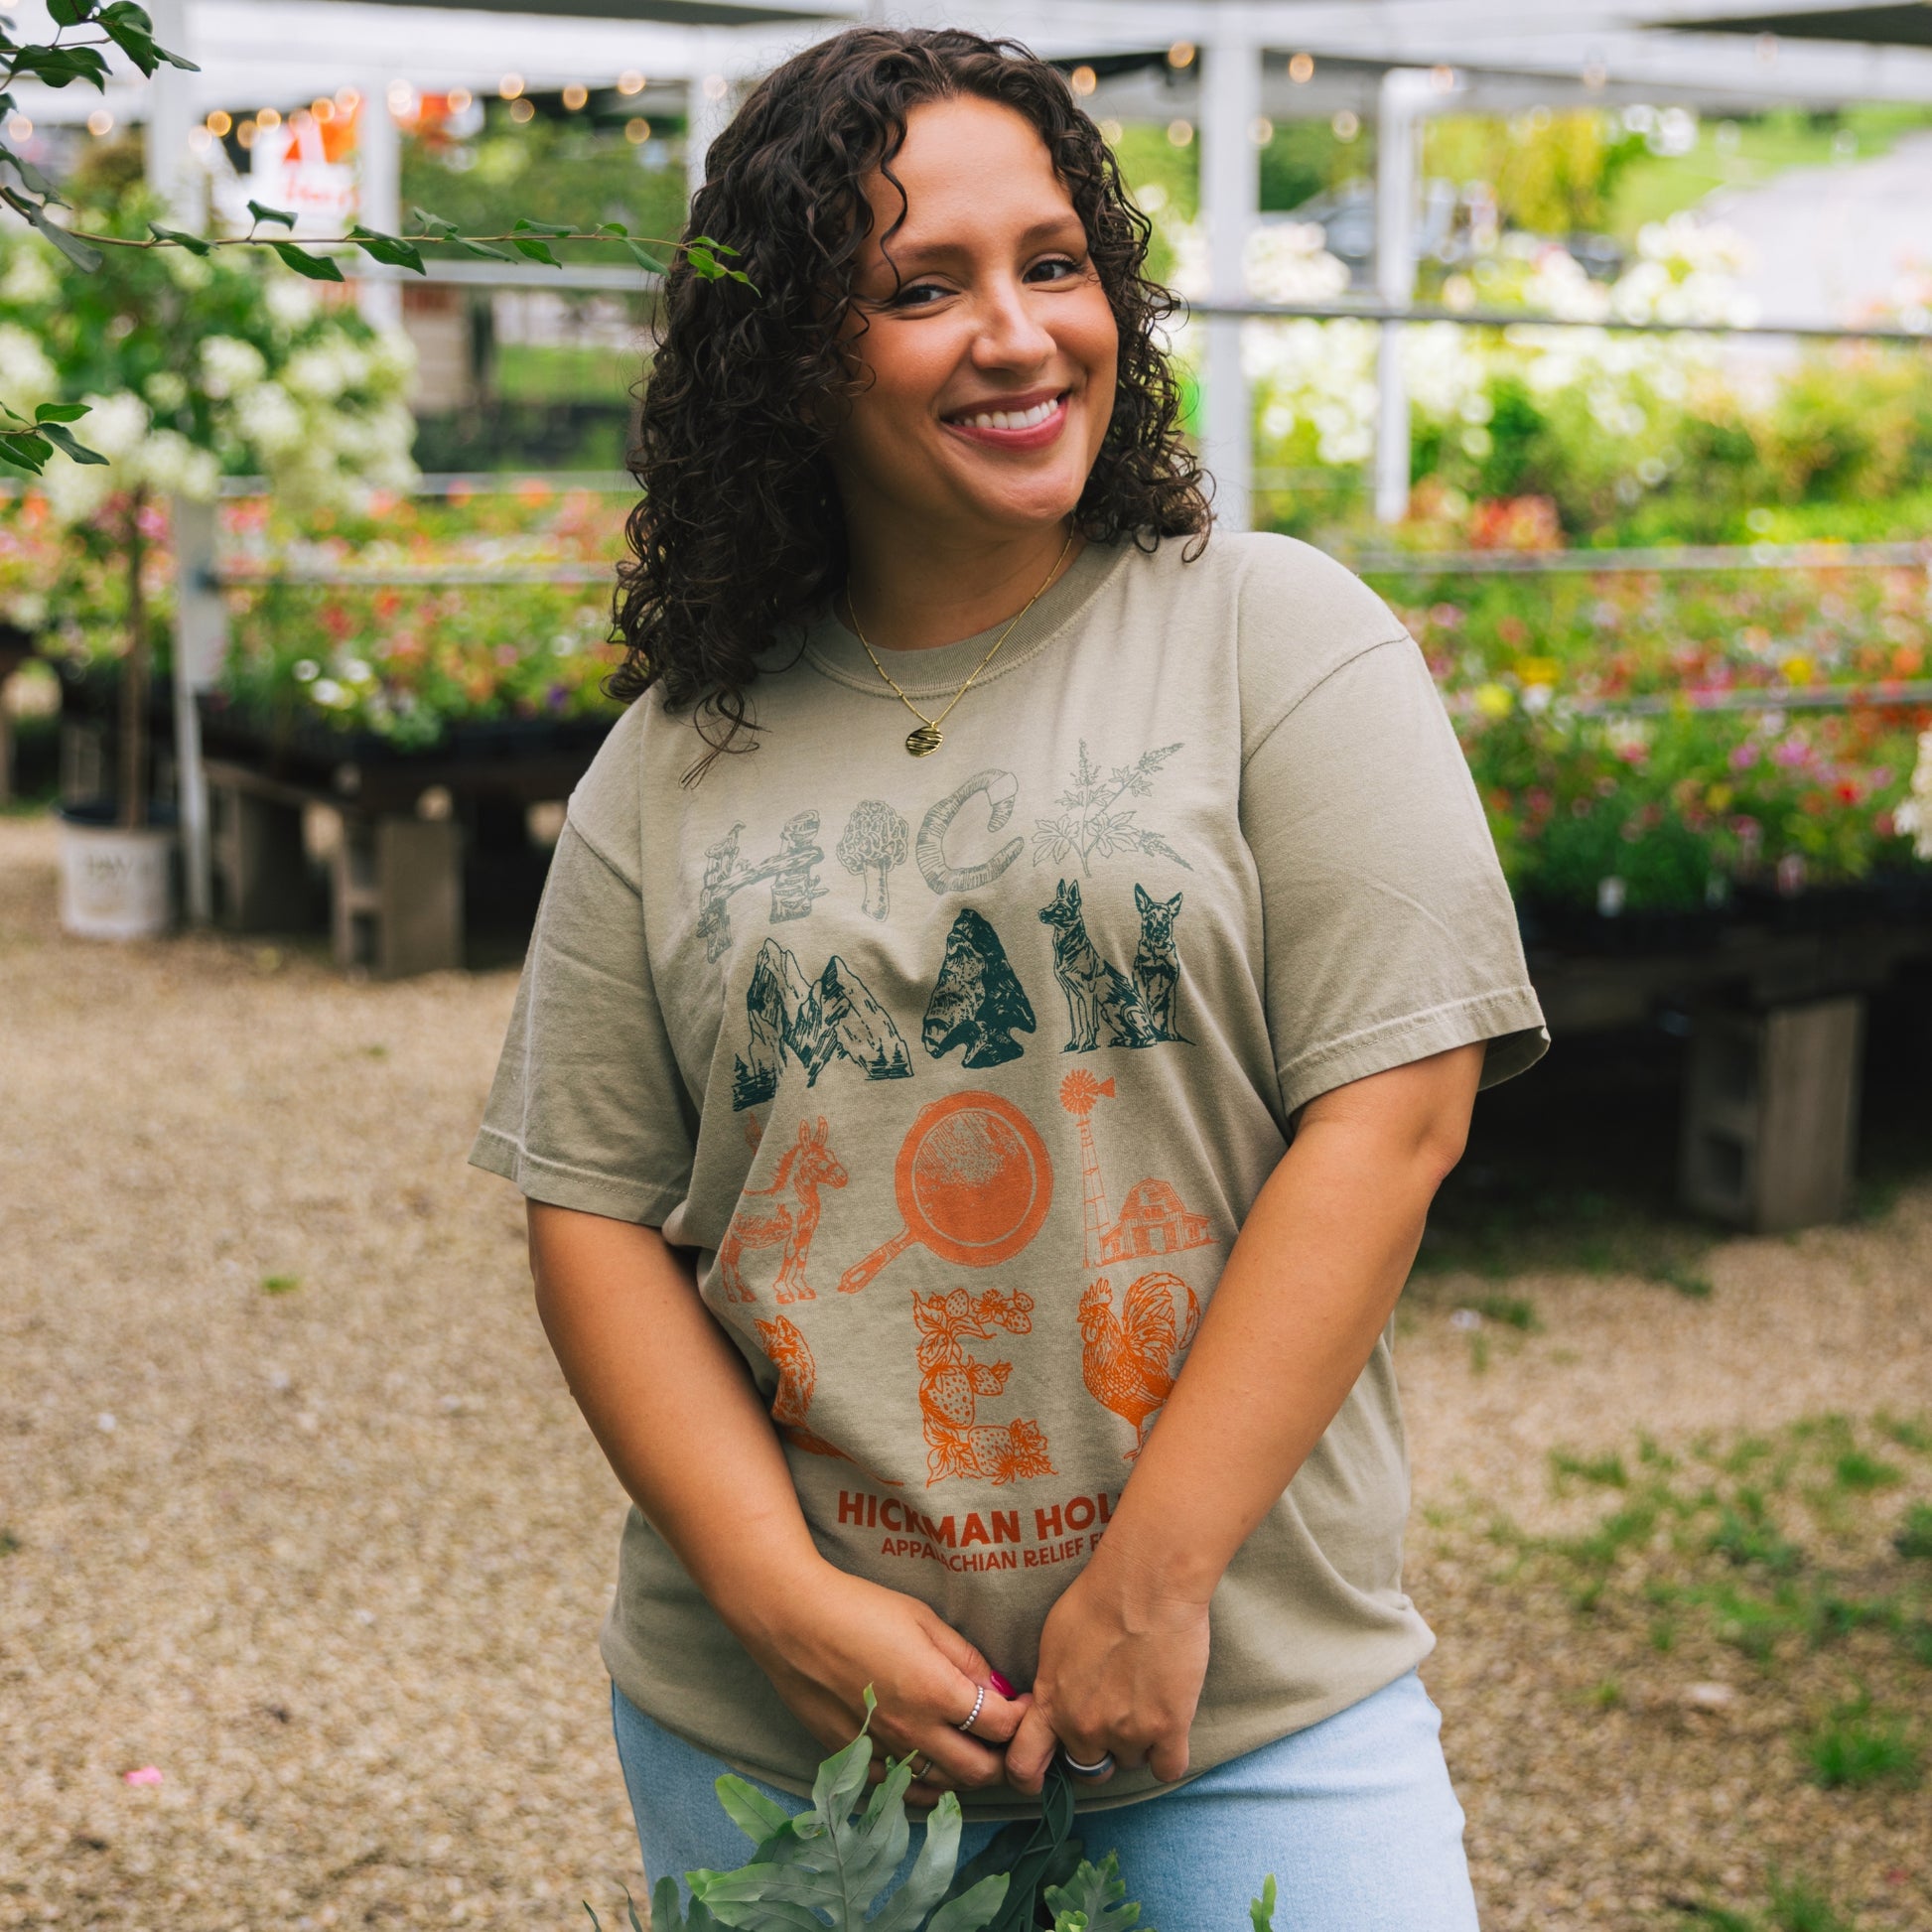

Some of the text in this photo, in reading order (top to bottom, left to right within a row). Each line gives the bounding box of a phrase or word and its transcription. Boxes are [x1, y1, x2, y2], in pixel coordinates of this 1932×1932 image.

[838, 1490, 1123, 1549] HICKMAN HOL
[1024, 1537, 1084, 1568] RELIEF
[1089, 1532, 1104, 1553] F
